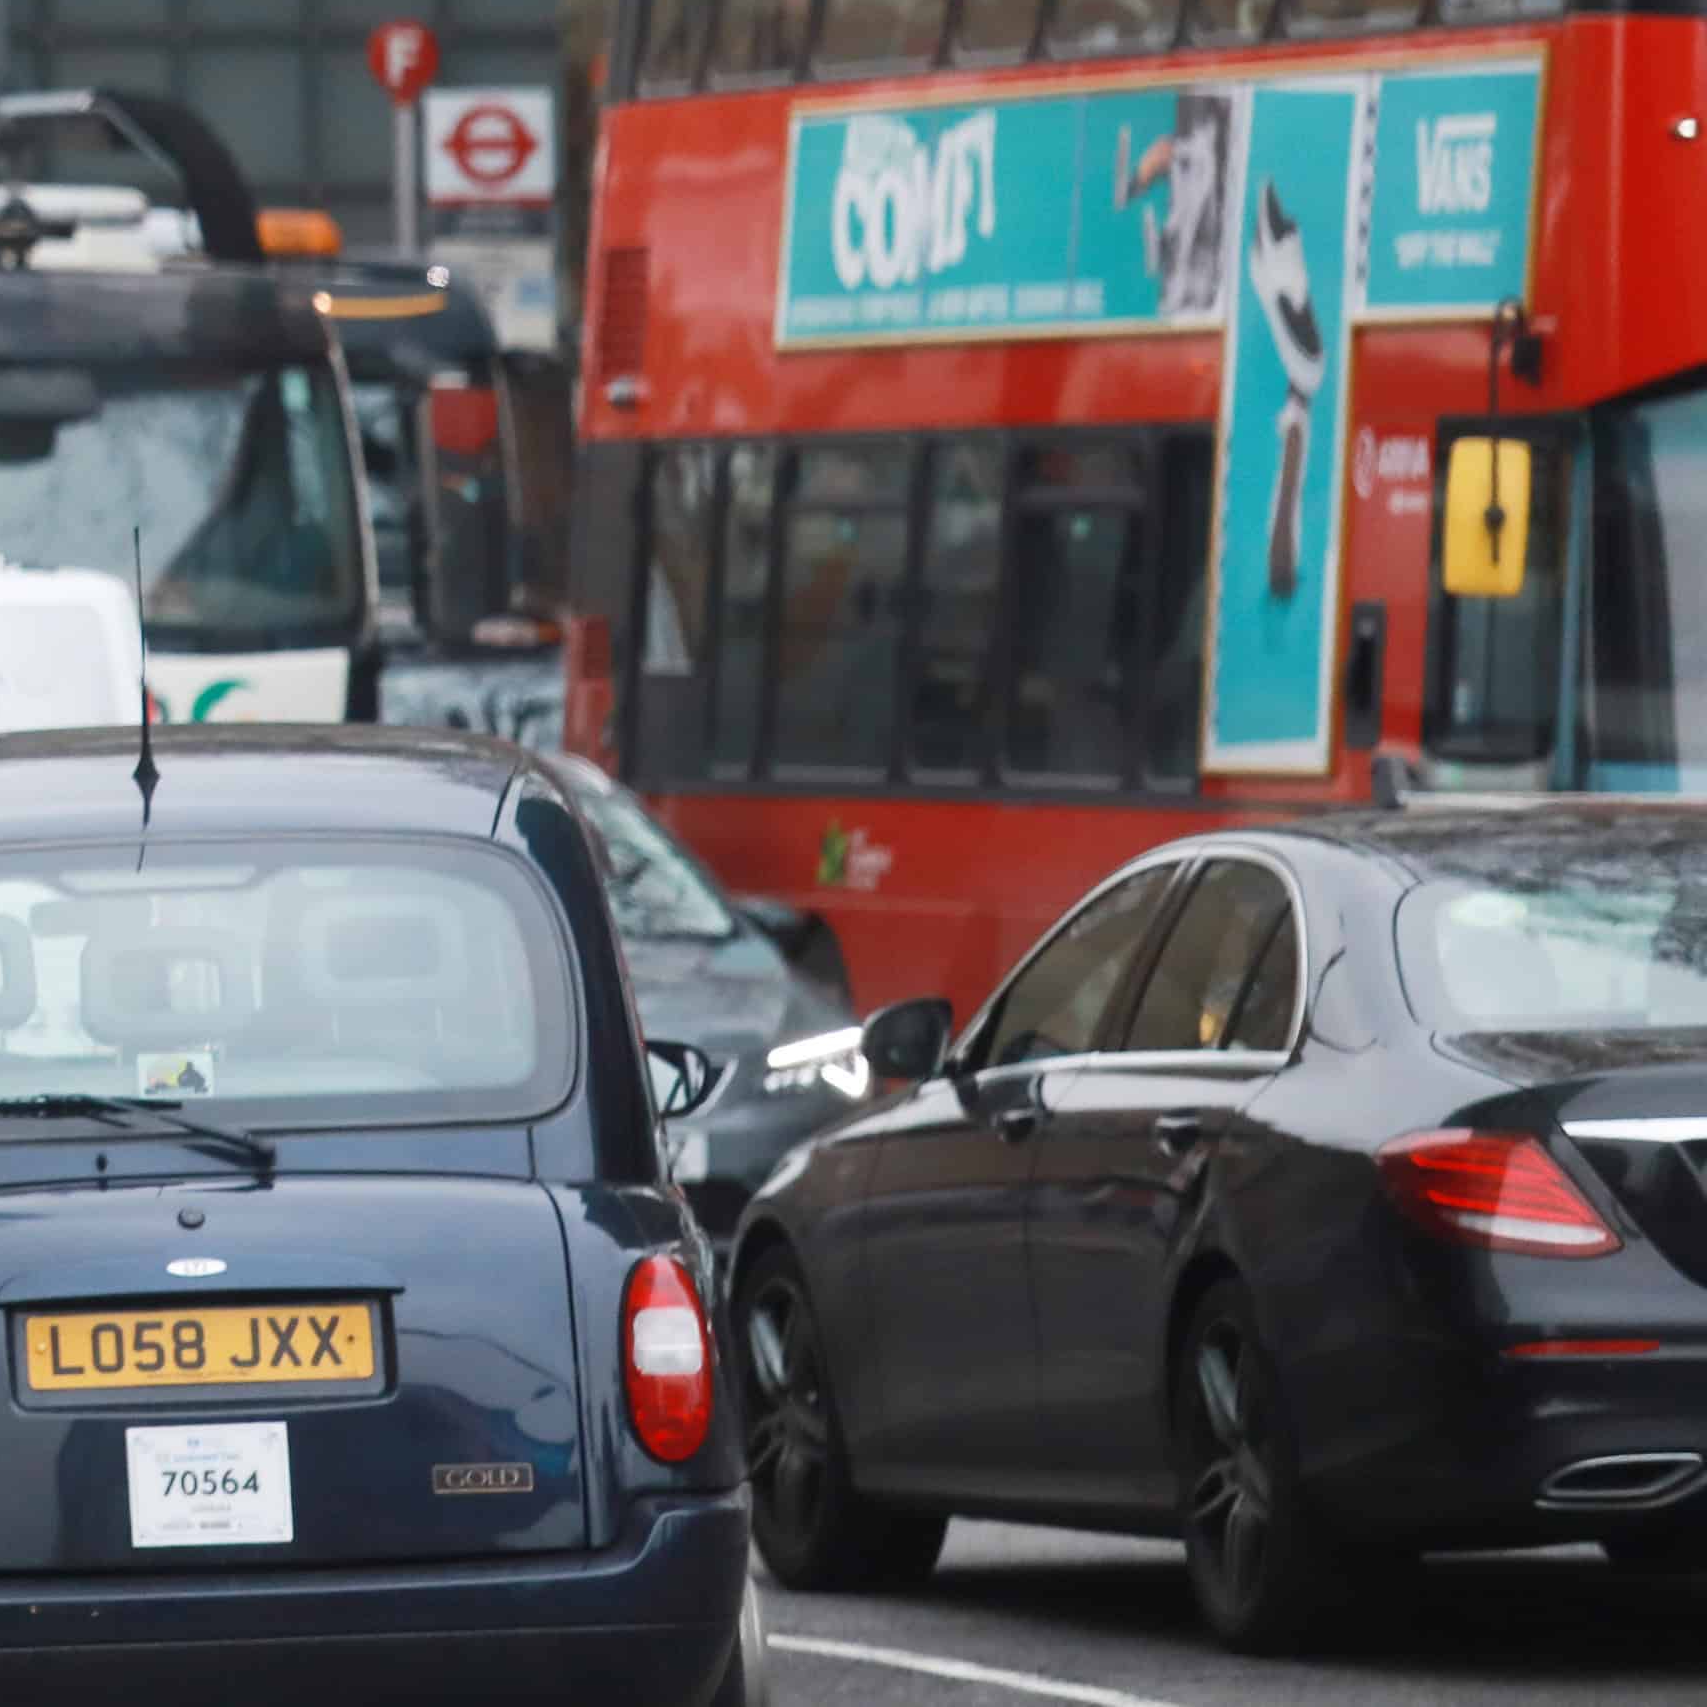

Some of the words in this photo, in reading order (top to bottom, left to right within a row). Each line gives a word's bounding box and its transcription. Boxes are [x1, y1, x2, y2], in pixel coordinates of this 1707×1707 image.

[1416, 110, 1497, 214] VANS
[49, 1319, 207, 1377] LO58
[229, 1314, 343, 1368] JXX
[160, 1468, 261, 1498] 70564
[444, 1468, 520, 1487] GOLD
